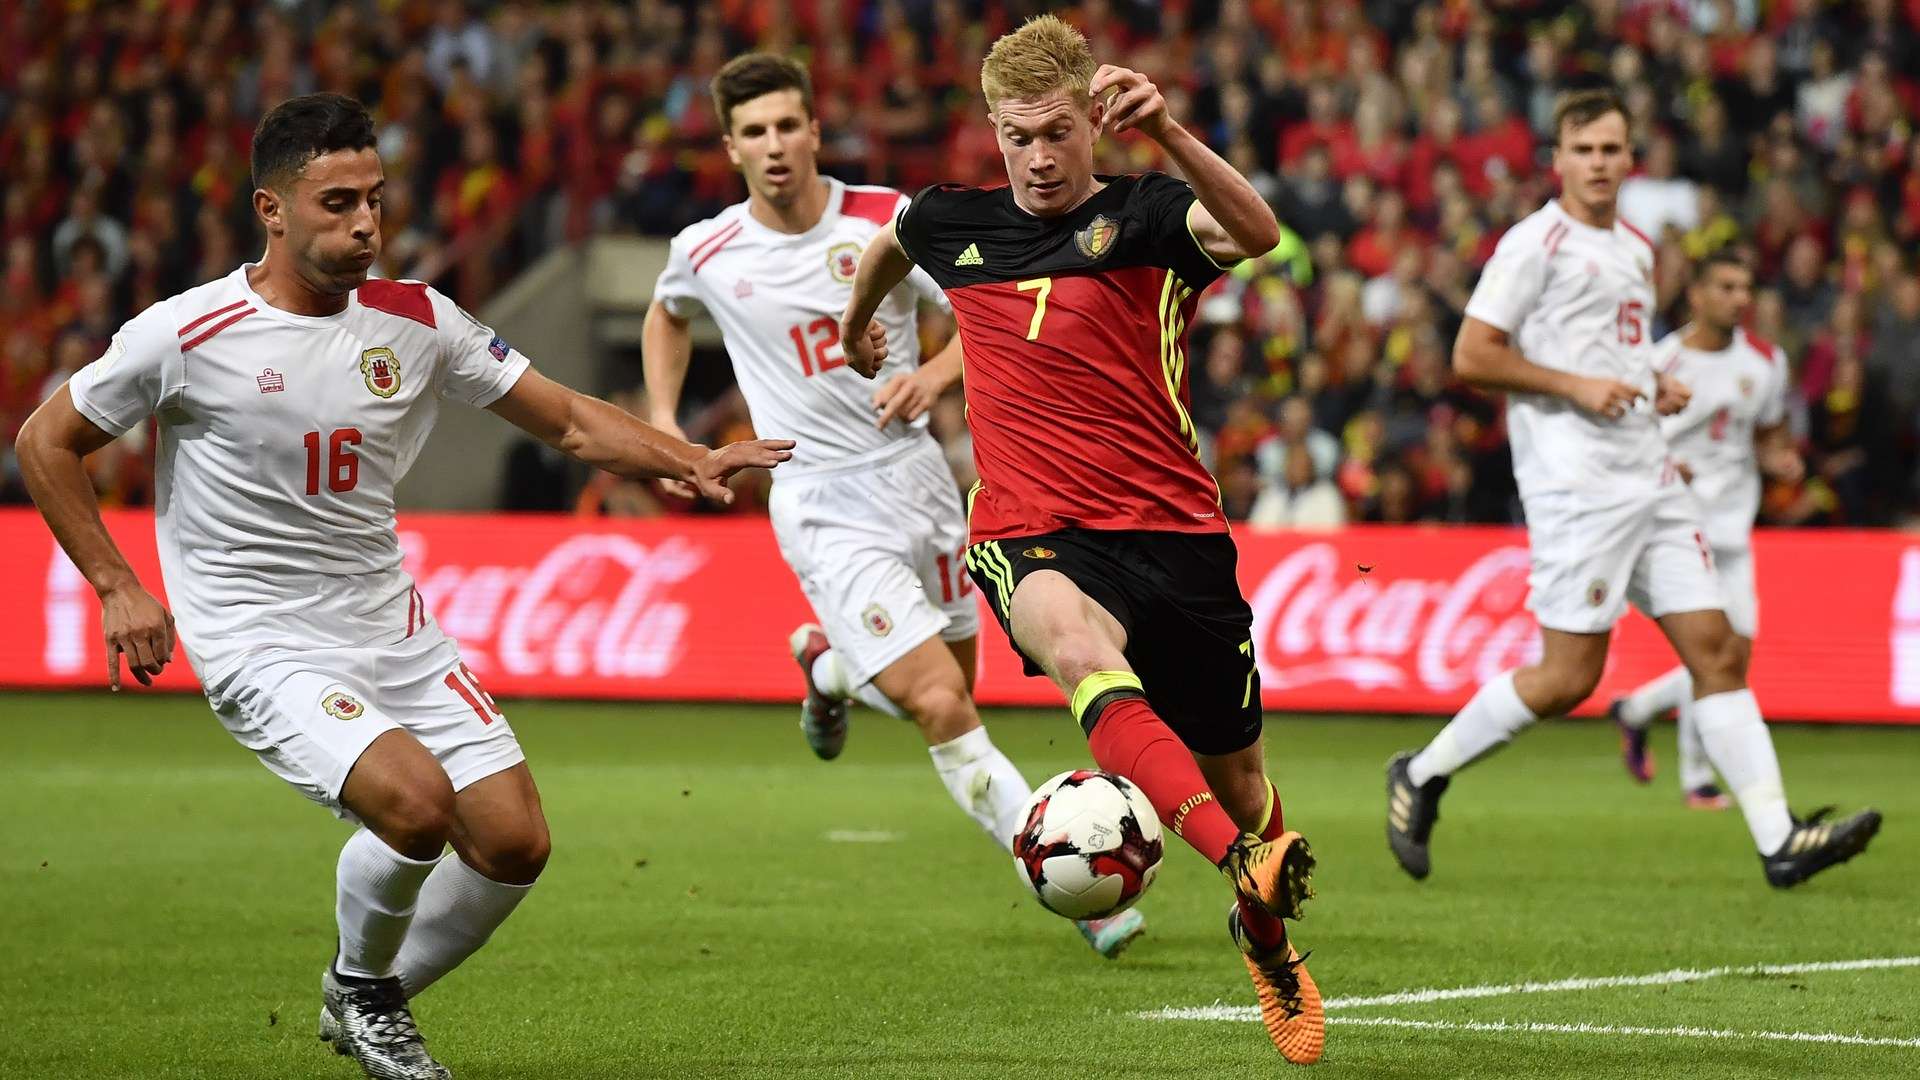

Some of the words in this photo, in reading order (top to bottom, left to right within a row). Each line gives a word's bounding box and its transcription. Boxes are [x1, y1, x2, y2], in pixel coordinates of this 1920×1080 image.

[955, 257, 984, 267] adidas
[1016, 276, 1052, 341] 7
[1616, 299, 1643, 346] 15
[789, 315, 846, 378] 12
[303, 427, 363, 496] 16
[1250, 542, 1545, 692] Coca-Co
[1238, 639, 1257, 709] 7
[1174, 791, 1213, 836] BELGIUM
